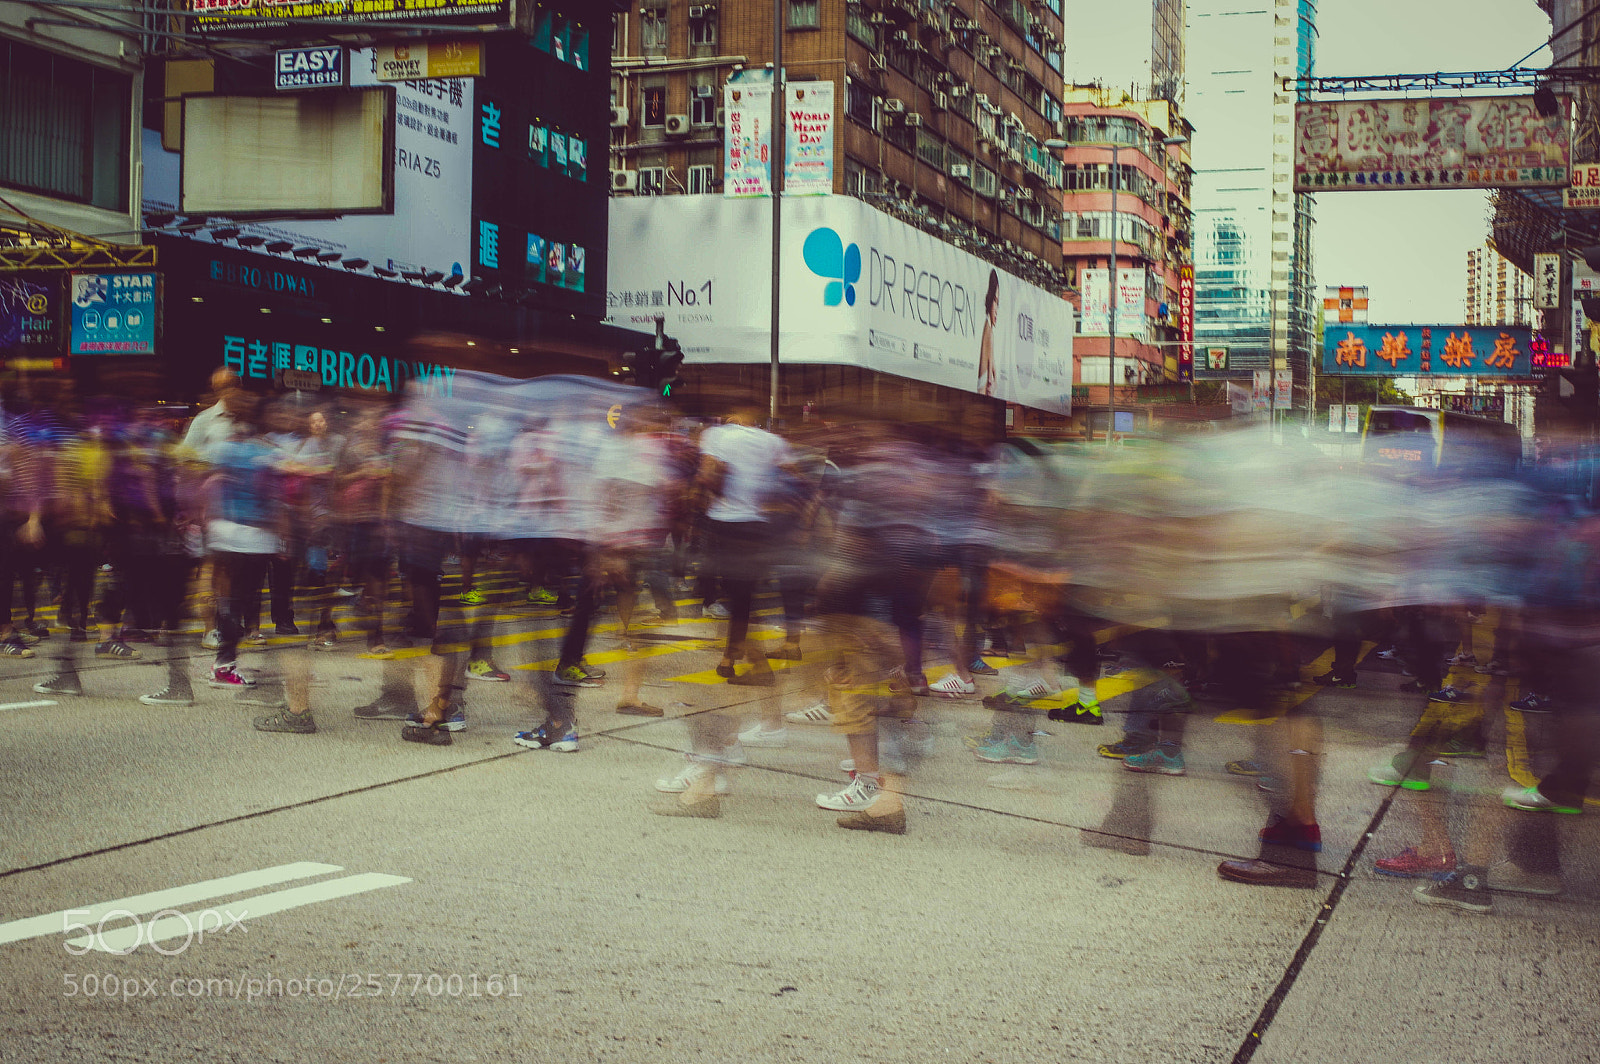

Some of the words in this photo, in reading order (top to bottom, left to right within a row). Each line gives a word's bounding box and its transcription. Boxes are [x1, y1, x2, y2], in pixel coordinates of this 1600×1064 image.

[279, 49, 340, 72] EASY
[383, 59, 420, 71] CONVEY
[279, 71, 339, 86] 62421618
[424, 155, 442, 179] Z5
[113, 275, 153, 288] STAR
[667, 279, 713, 307] No.1
[869, 246, 896, 314] DR
[902, 262, 977, 339] REBORN
[21, 316, 53, 331] Hair
[1180, 279, 1193, 361] McDonald's
[321, 348, 457, 400] BROADWAY
